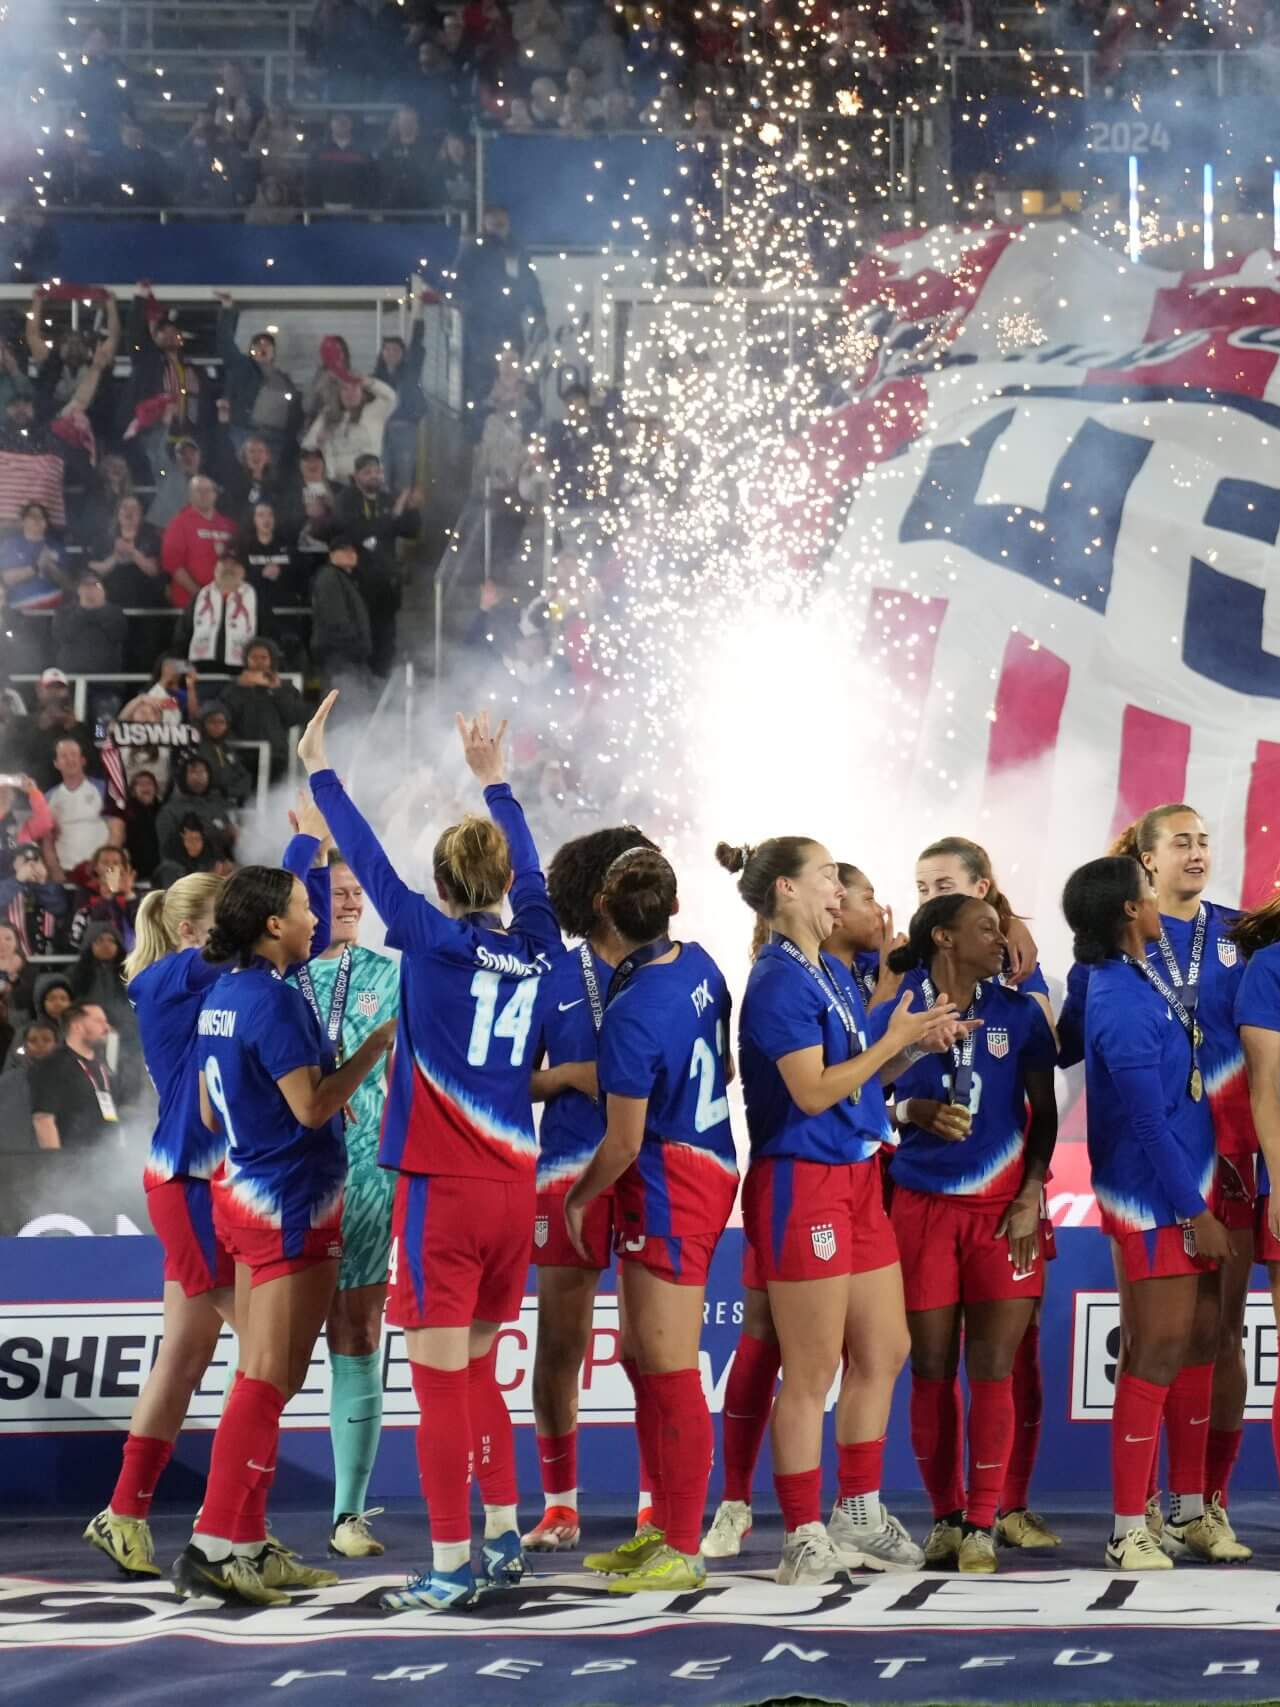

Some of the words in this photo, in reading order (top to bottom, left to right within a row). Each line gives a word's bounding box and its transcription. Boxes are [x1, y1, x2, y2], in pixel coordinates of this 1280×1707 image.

[1090, 122, 1170, 152] 2024
[1186, 961, 1200, 986] 2024
[690, 978, 714, 1018] FOX
[467, 969, 541, 1067] 14
[988, 1033, 1008, 1045] USA
[813, 1230, 835, 1245] USA
[491, 1328, 622, 1391] CP
[482, 1435, 490, 1464] USA
